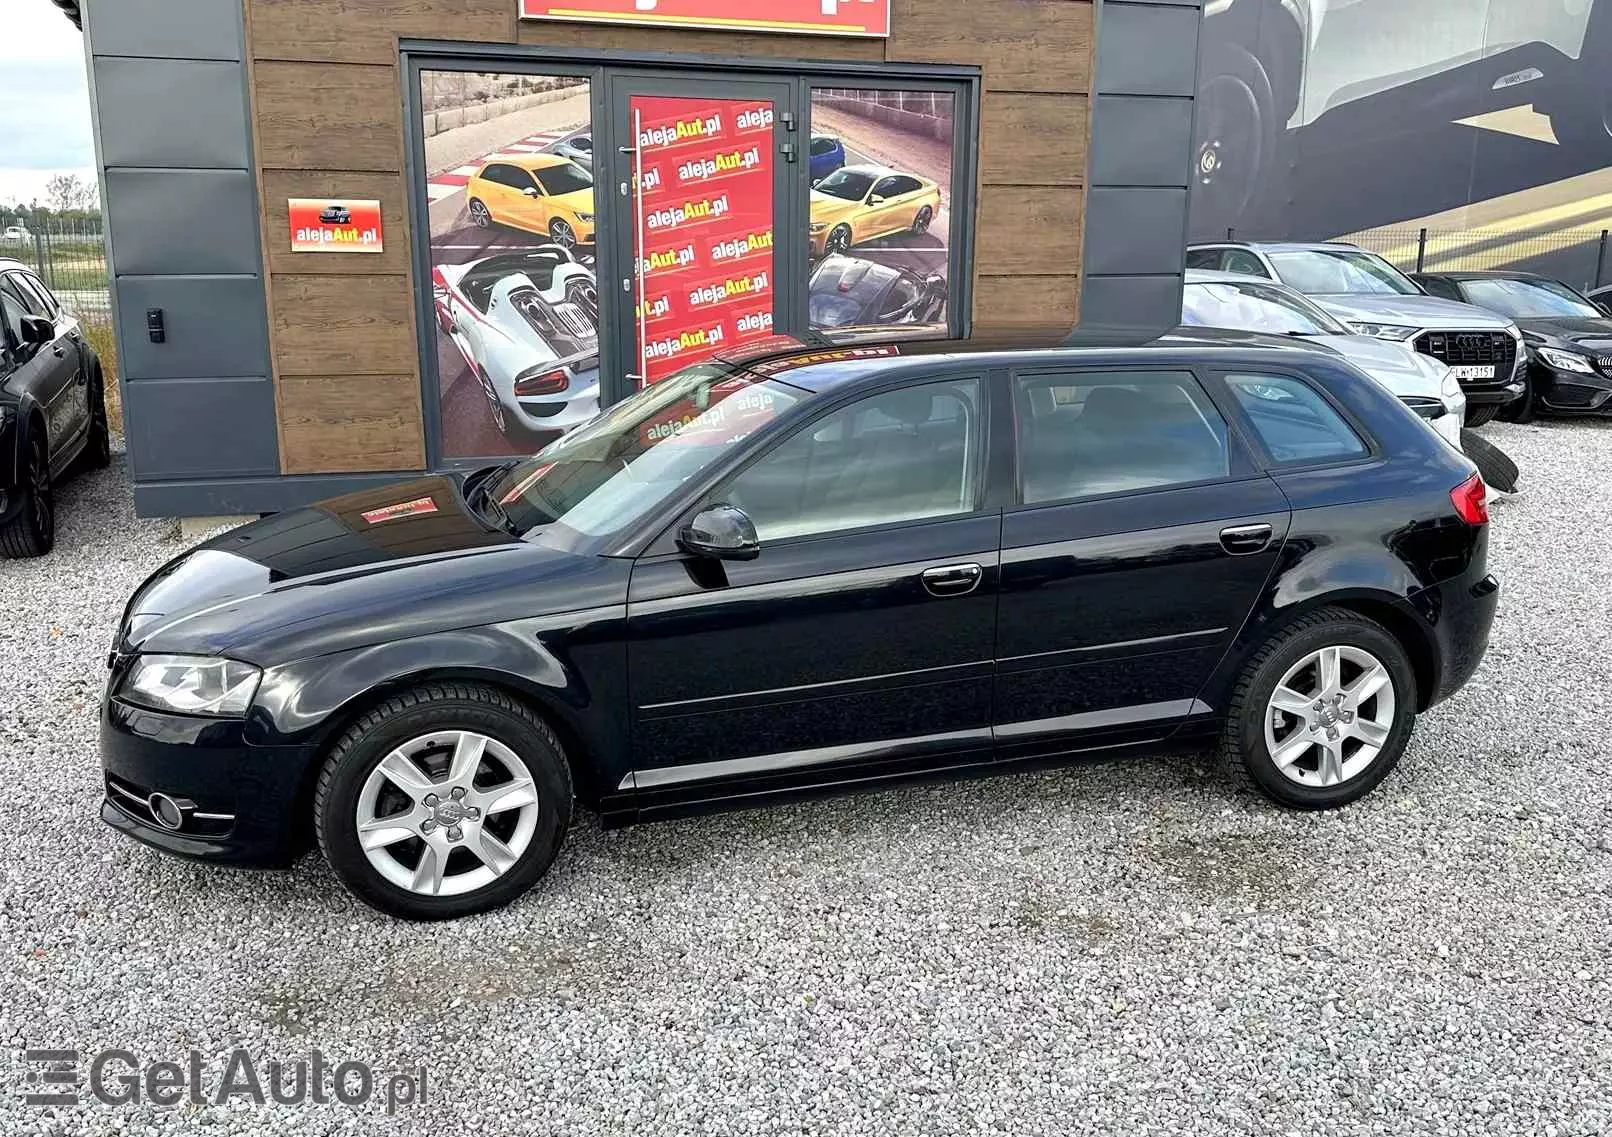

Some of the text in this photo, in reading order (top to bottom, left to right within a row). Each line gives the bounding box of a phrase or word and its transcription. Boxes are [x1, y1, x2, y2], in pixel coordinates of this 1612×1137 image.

[640, 114, 721, 147] alejaAut.pl
[678, 147, 760, 180] alejaAut.pl
[647, 195, 729, 229] alejaAut.pl
[296, 226, 377, 245] alejaAut.pl
[689, 272, 768, 305] alejaAut.pl
[645, 325, 724, 358] alejaAut.pl
